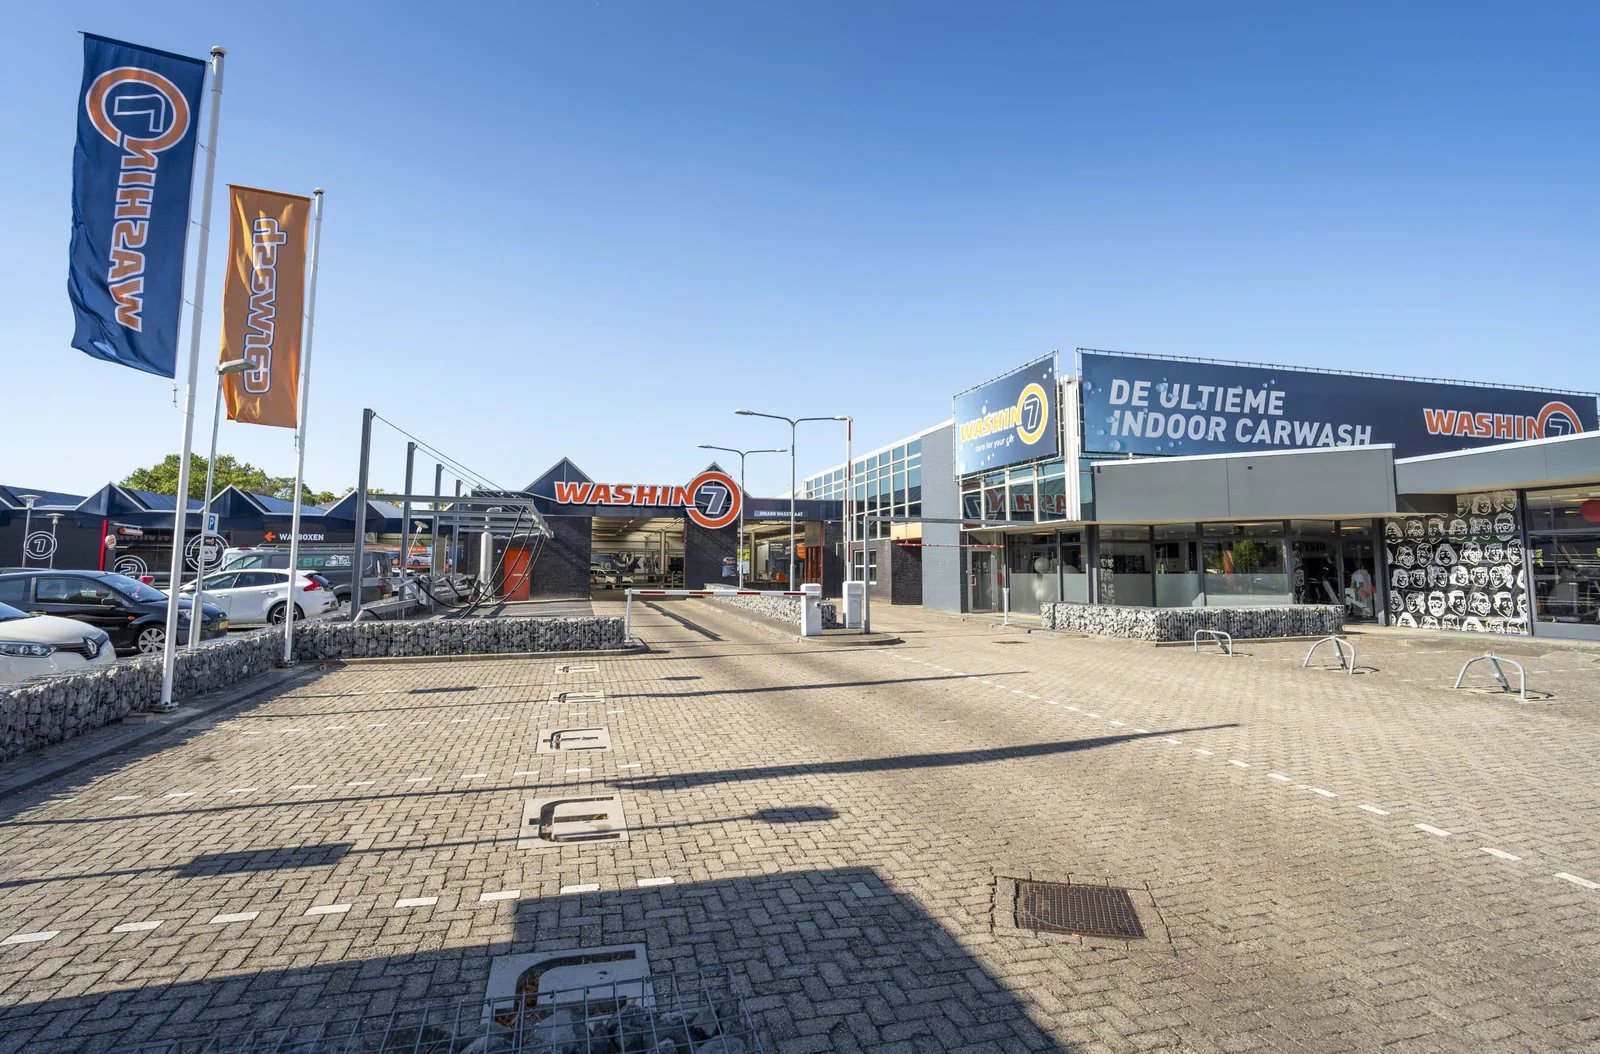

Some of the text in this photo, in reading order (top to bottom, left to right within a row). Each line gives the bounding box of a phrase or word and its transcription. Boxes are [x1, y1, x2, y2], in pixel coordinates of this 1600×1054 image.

[1109, 378, 1286, 416] DE ULTIEME
[959, 397, 1040, 442] WASHIN 7
[1109, 409, 1372, 447] INDOOR CARWASH
[1423, 408, 1545, 440] WASHIN
[554, 481, 727, 515] WASHIN 7
[279, 533, 324, 541] WABOXEN
